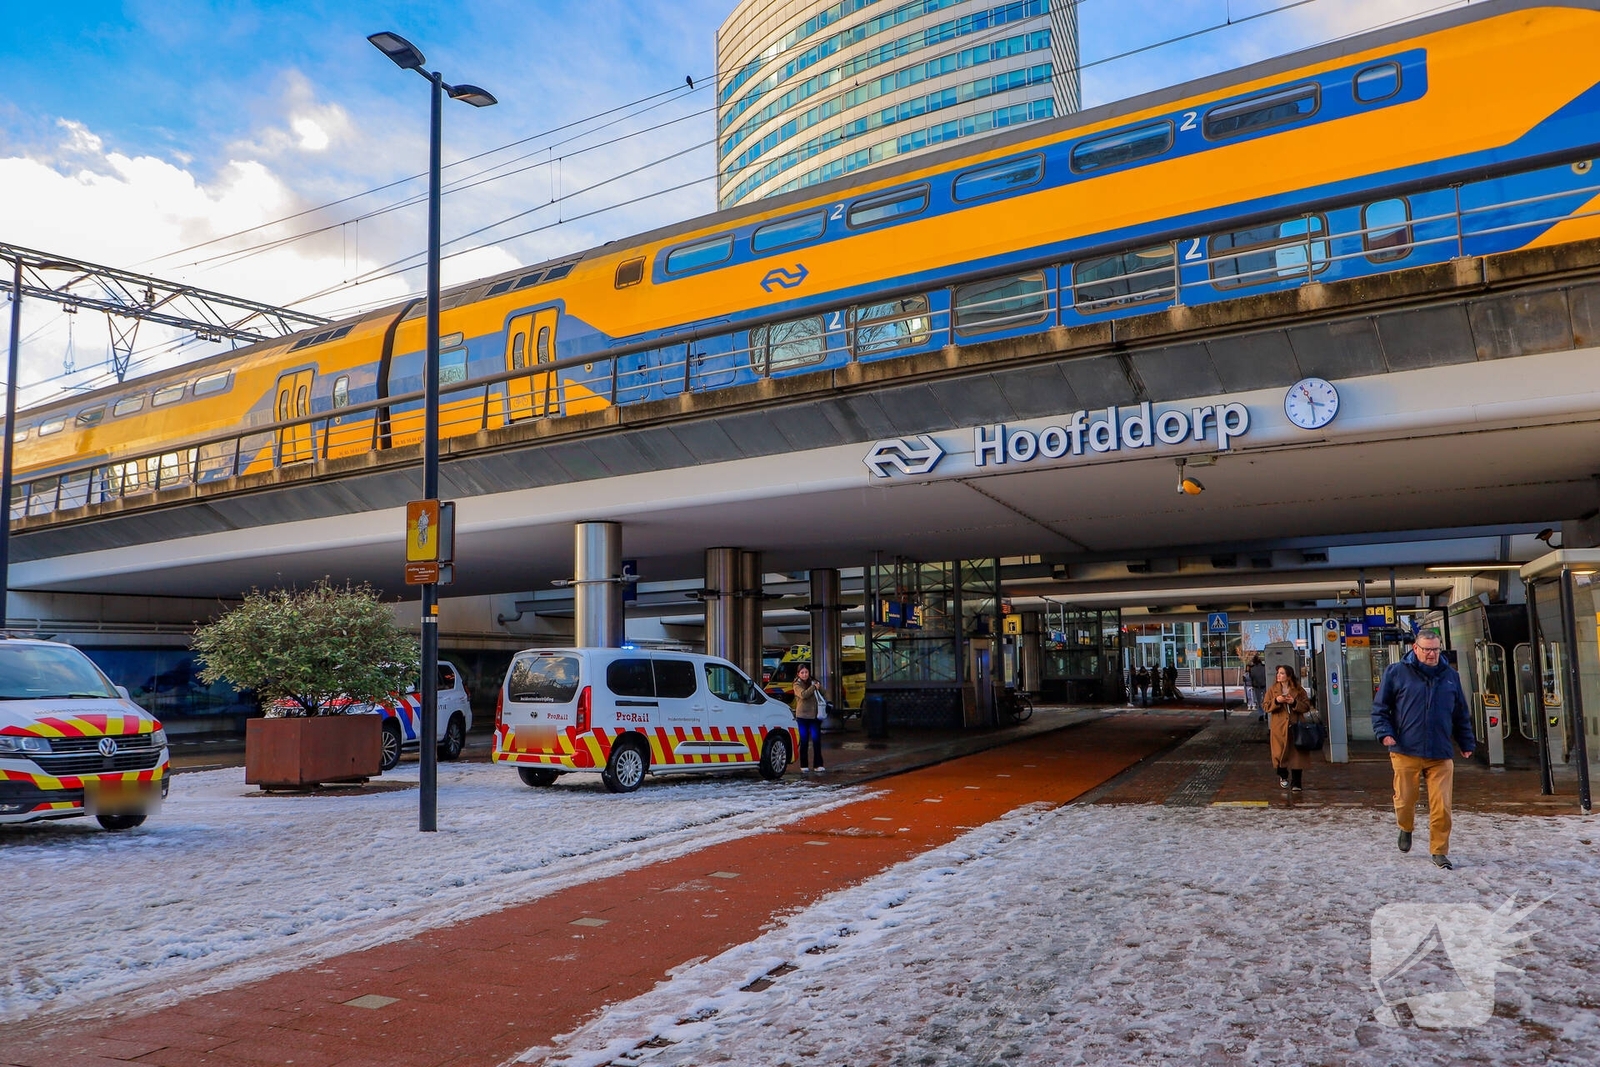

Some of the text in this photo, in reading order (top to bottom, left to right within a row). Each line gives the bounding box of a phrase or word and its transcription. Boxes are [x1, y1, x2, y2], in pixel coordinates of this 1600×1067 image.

[1180, 111, 1197, 132] 2
[830, 203, 845, 221] 2
[1185, 237, 1202, 260] 2
[828, 311, 842, 330] 2
[974, 401, 1251, 467] Hoofddorp
[547, 712, 568, 720] ProRail
[616, 711, 649, 722] ProRail
